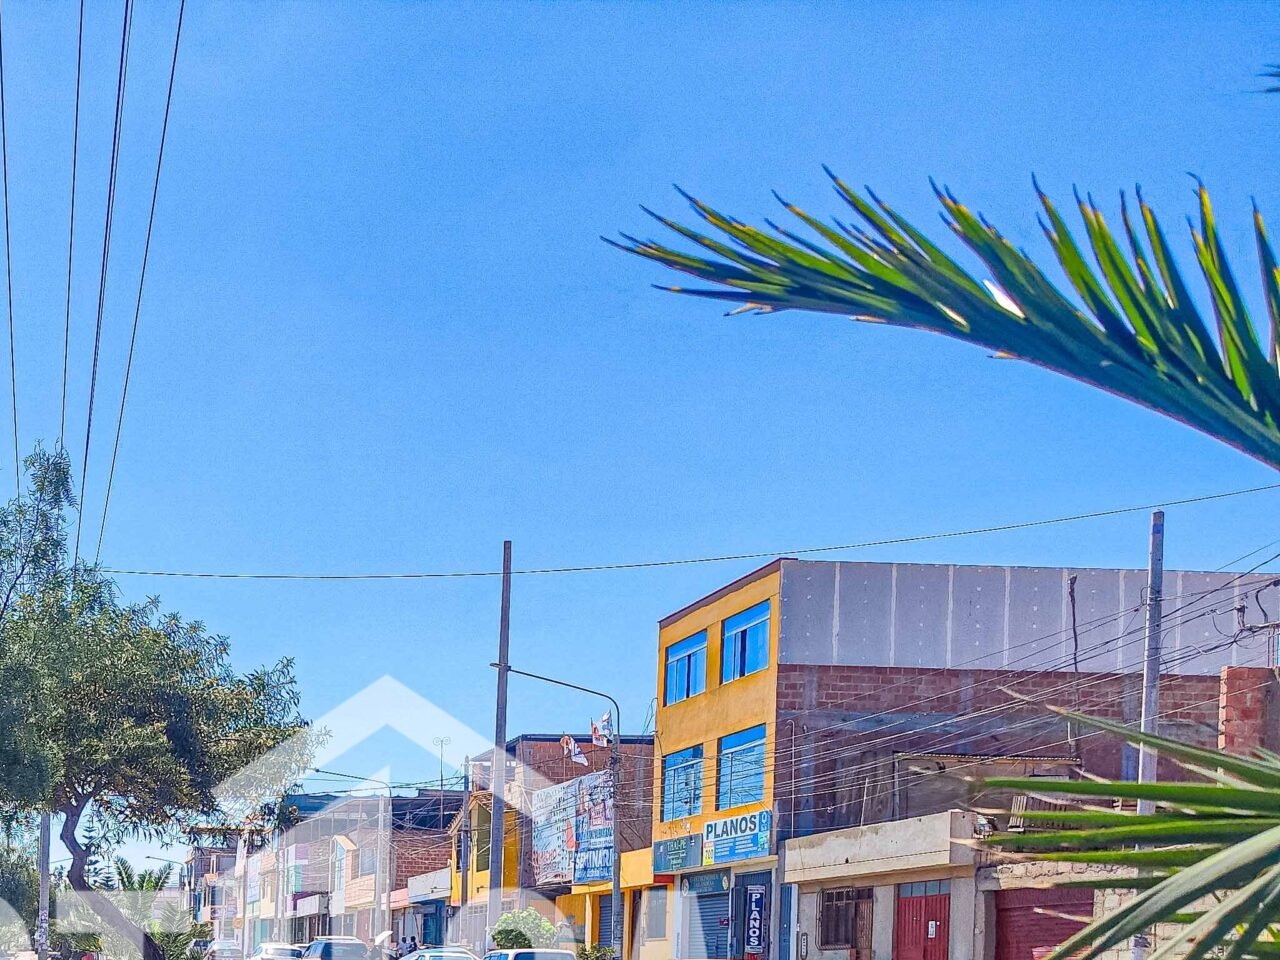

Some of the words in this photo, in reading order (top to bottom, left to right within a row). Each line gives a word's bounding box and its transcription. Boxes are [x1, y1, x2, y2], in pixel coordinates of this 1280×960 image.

[706, 815, 757, 840] PLANOS
[575, 848, 614, 869] SEMINARI
[749, 893, 761, 946] PLANOS
